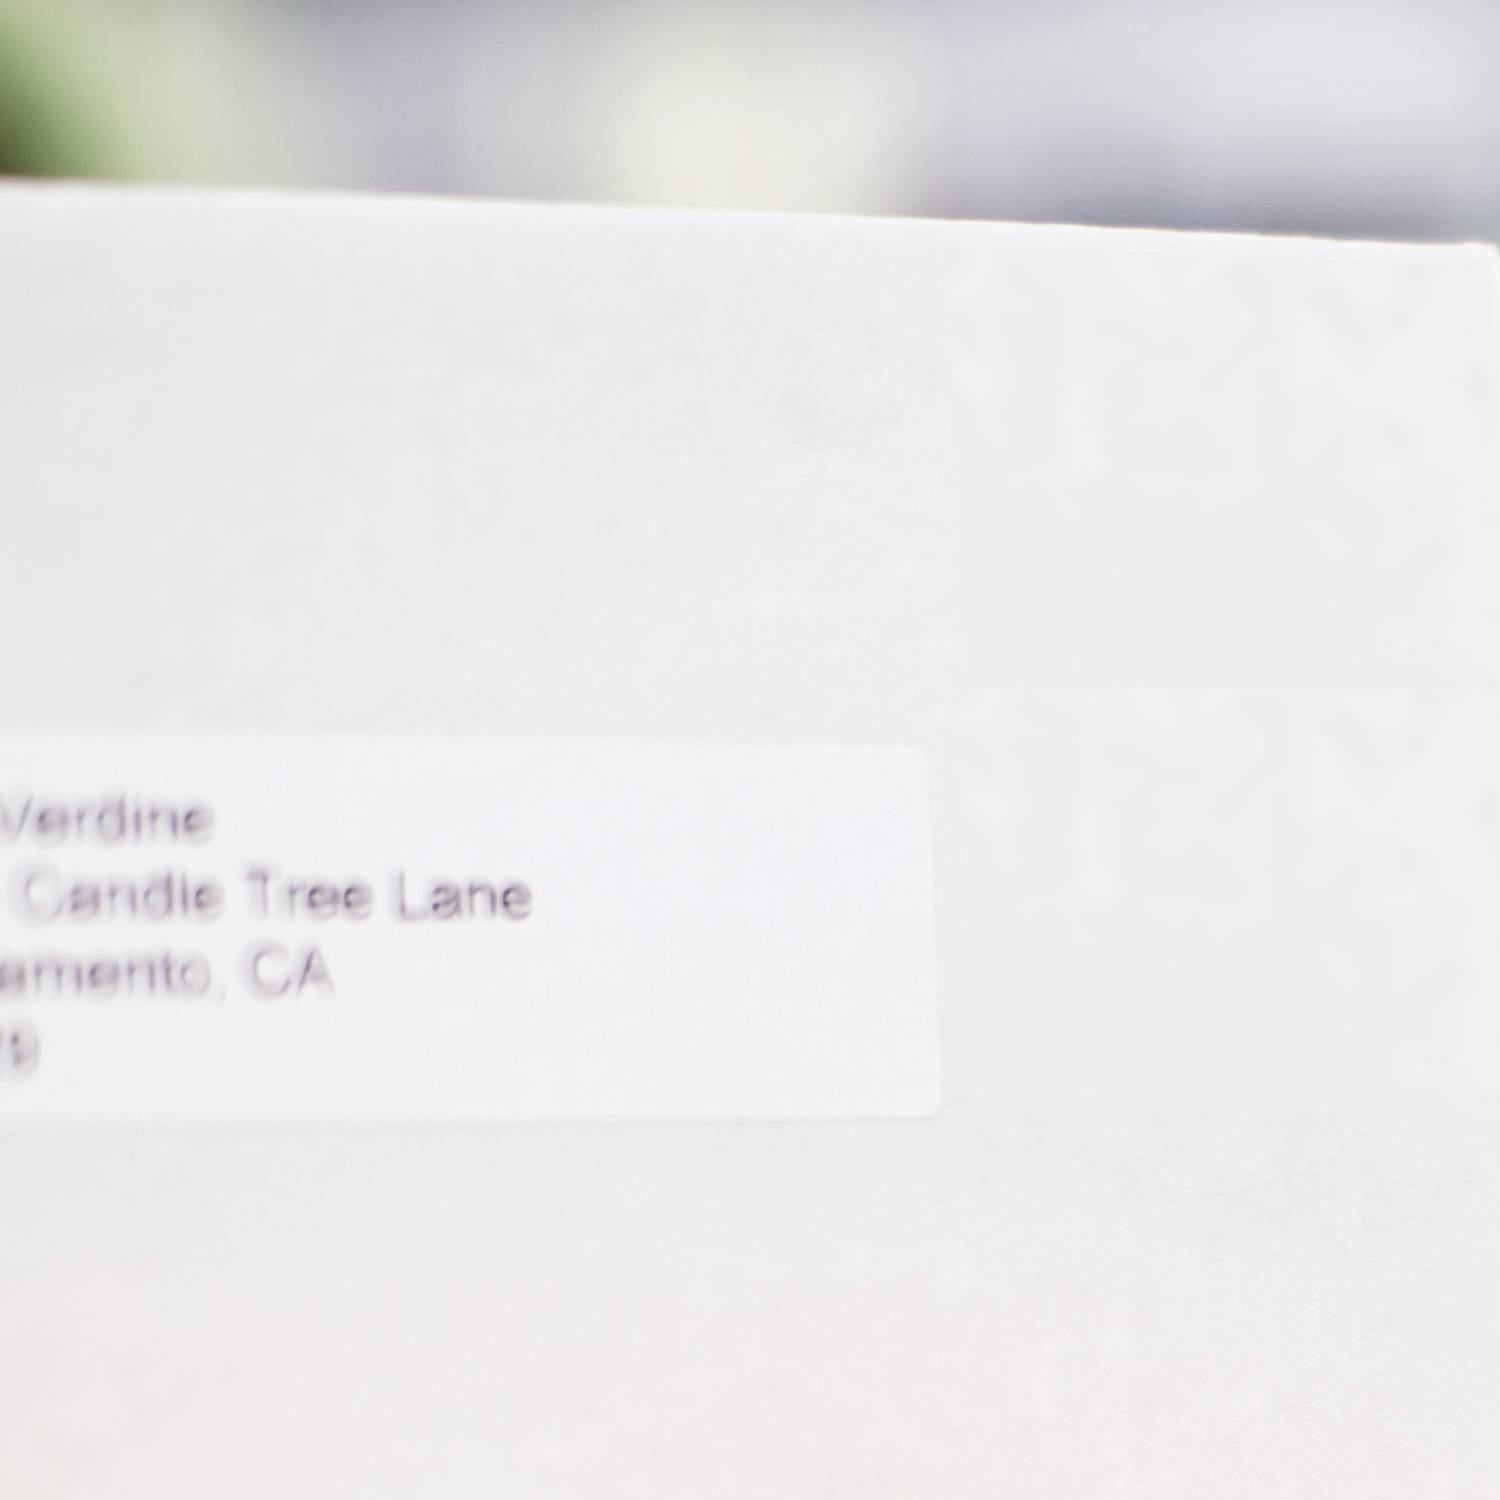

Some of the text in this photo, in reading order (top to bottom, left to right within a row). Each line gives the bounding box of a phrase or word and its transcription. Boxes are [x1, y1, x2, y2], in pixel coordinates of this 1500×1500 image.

[0, 793, 214, 843] Verdine
[20, 864, 533, 921] Candle Tree Lane
[248, 940, 334, 1000] CA
